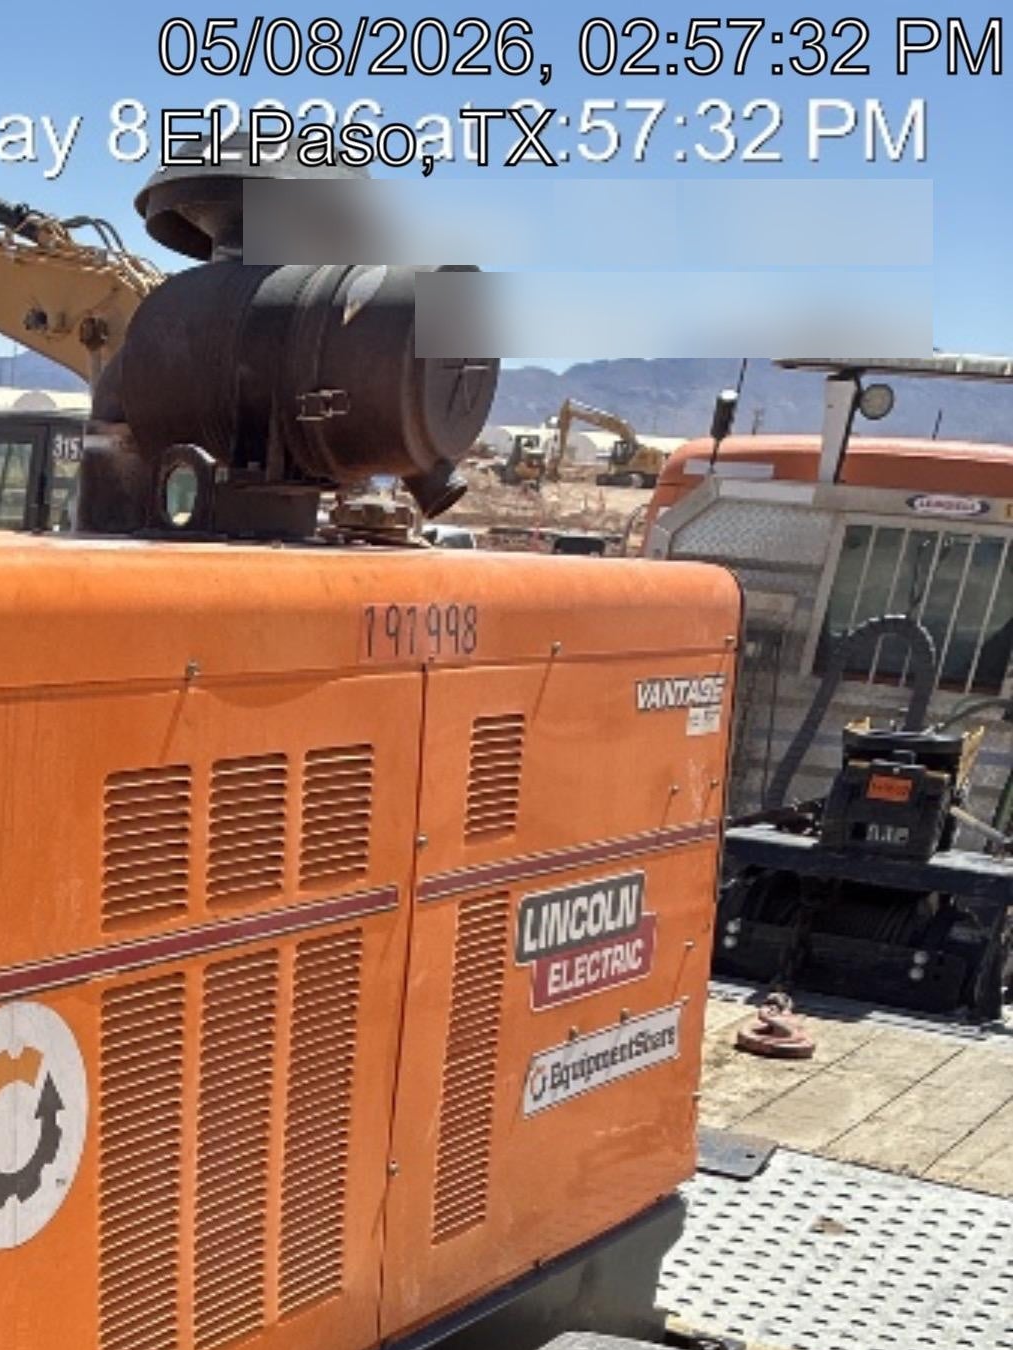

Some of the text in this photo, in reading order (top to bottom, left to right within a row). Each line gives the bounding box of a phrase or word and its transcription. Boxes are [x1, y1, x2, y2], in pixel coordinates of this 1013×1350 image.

[636, 675, 726, 711] VANTAGE
[522, 883, 640, 953] LINCOLN
[547, 938, 645, 997] ELECTRIC
